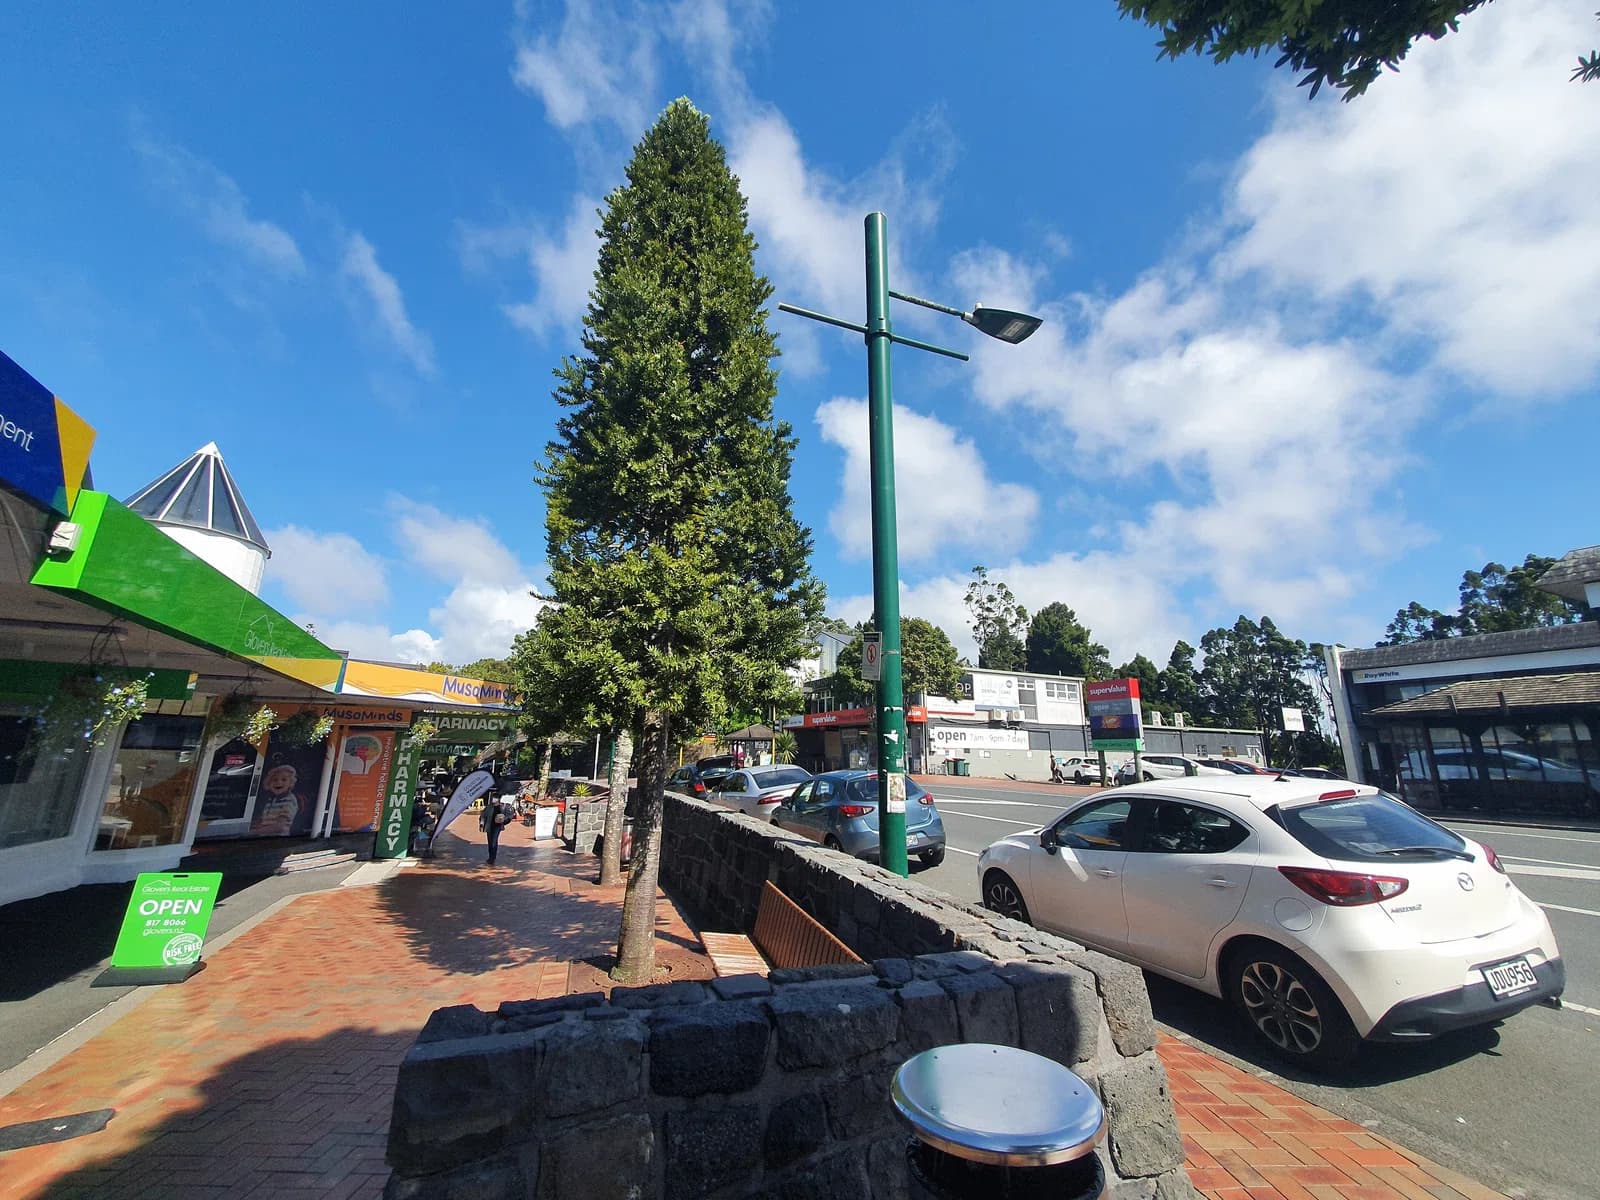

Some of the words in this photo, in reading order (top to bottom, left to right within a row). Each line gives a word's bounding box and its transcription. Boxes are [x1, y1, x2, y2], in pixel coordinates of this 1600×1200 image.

[937, 731, 967, 743] open
[386, 739, 413, 851] PHARMACY
[139, 899, 203, 916] OPEN
[145, 919, 161, 927] 817
[166, 946, 183, 958] RISK
